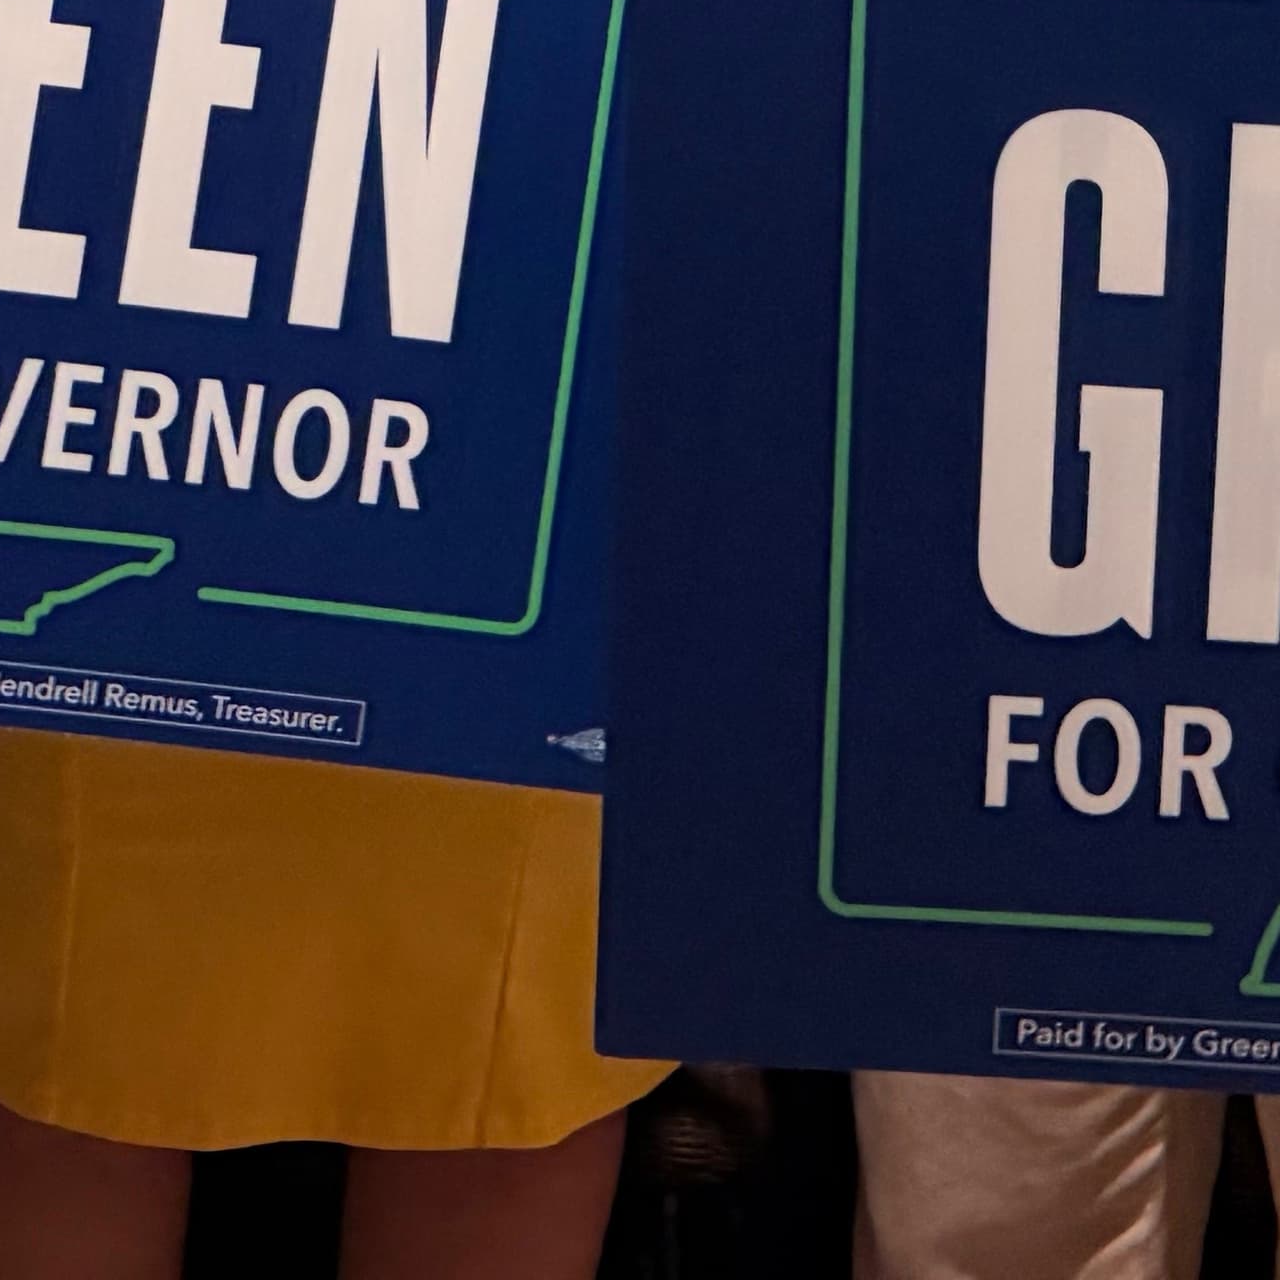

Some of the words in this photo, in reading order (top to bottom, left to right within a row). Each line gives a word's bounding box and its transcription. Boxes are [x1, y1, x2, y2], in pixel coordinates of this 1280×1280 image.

[104, 682, 204, 722] Remus,
[211, 695, 344, 733] Treasurer.
[986, 696, 1232, 819] FOR
[1017, 1018, 1084, 1048] Paid
[1092, 1023, 1133, 1051] for
[1146, 1026, 1184, 1061] by
